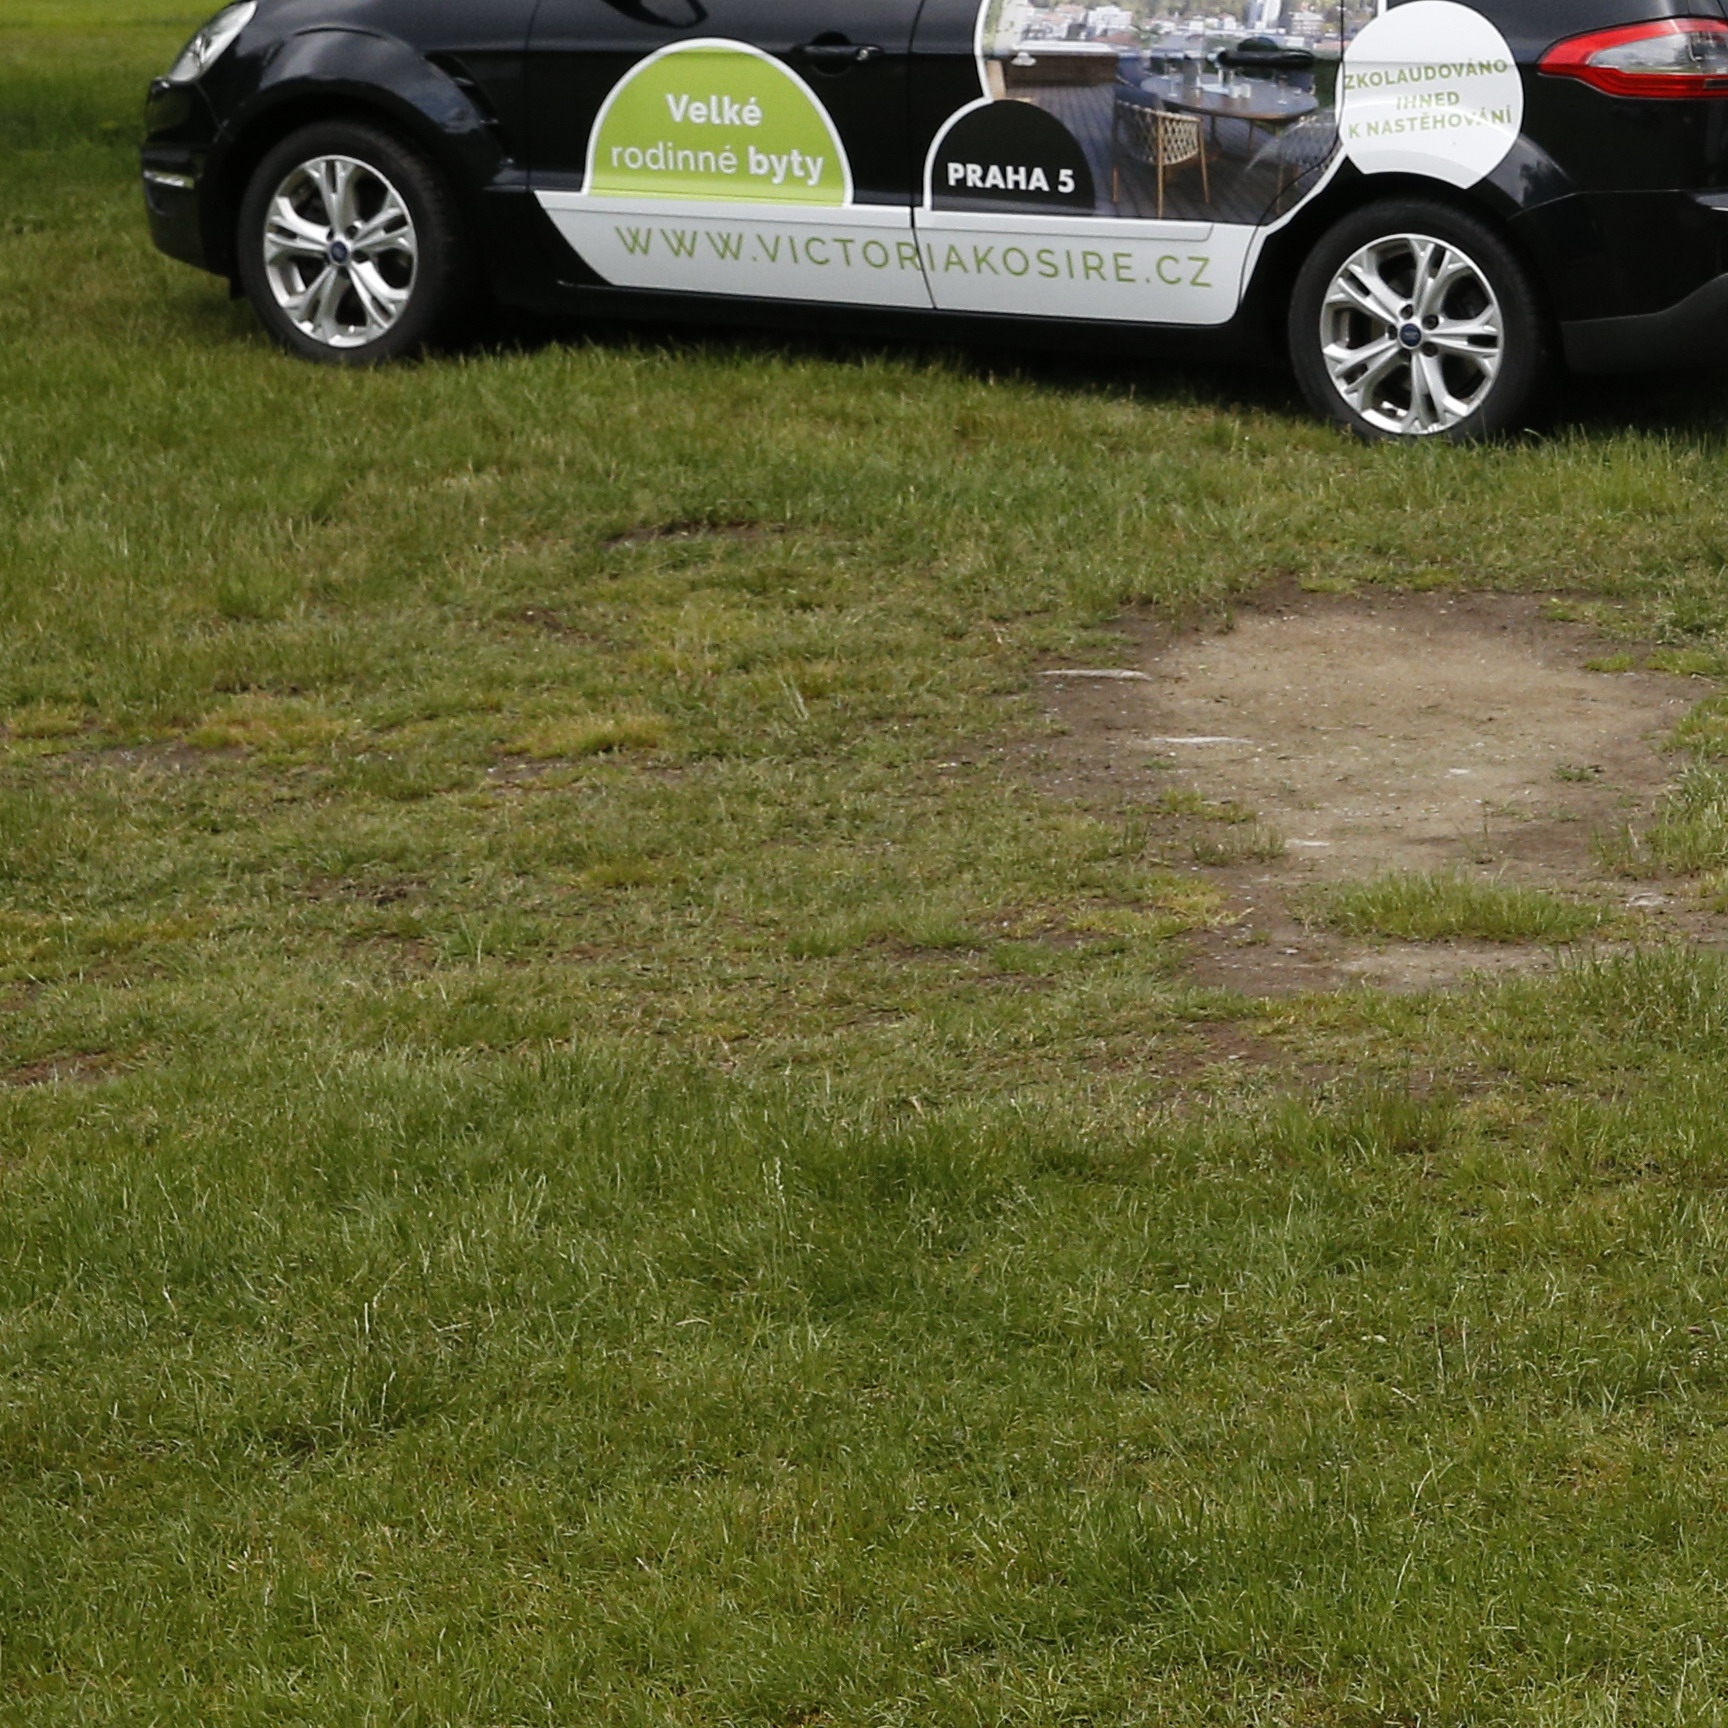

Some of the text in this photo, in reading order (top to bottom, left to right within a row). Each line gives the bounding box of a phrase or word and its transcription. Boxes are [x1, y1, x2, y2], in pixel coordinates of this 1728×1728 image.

[1345, 58, 1508, 90] ZKOLAUDOVÁNO
[665, 93, 762, 127] Velké
[1396, 91, 1460, 111] IHNED
[1349, 105, 1512, 139] K NASTĚHOVÁNÍ
[612, 142, 824, 186] rodinné byty
[946, 162, 1076, 194] PRAHA 5
[614, 225, 1213, 289] WWW.VICTORIAKOSIRE.CZ
